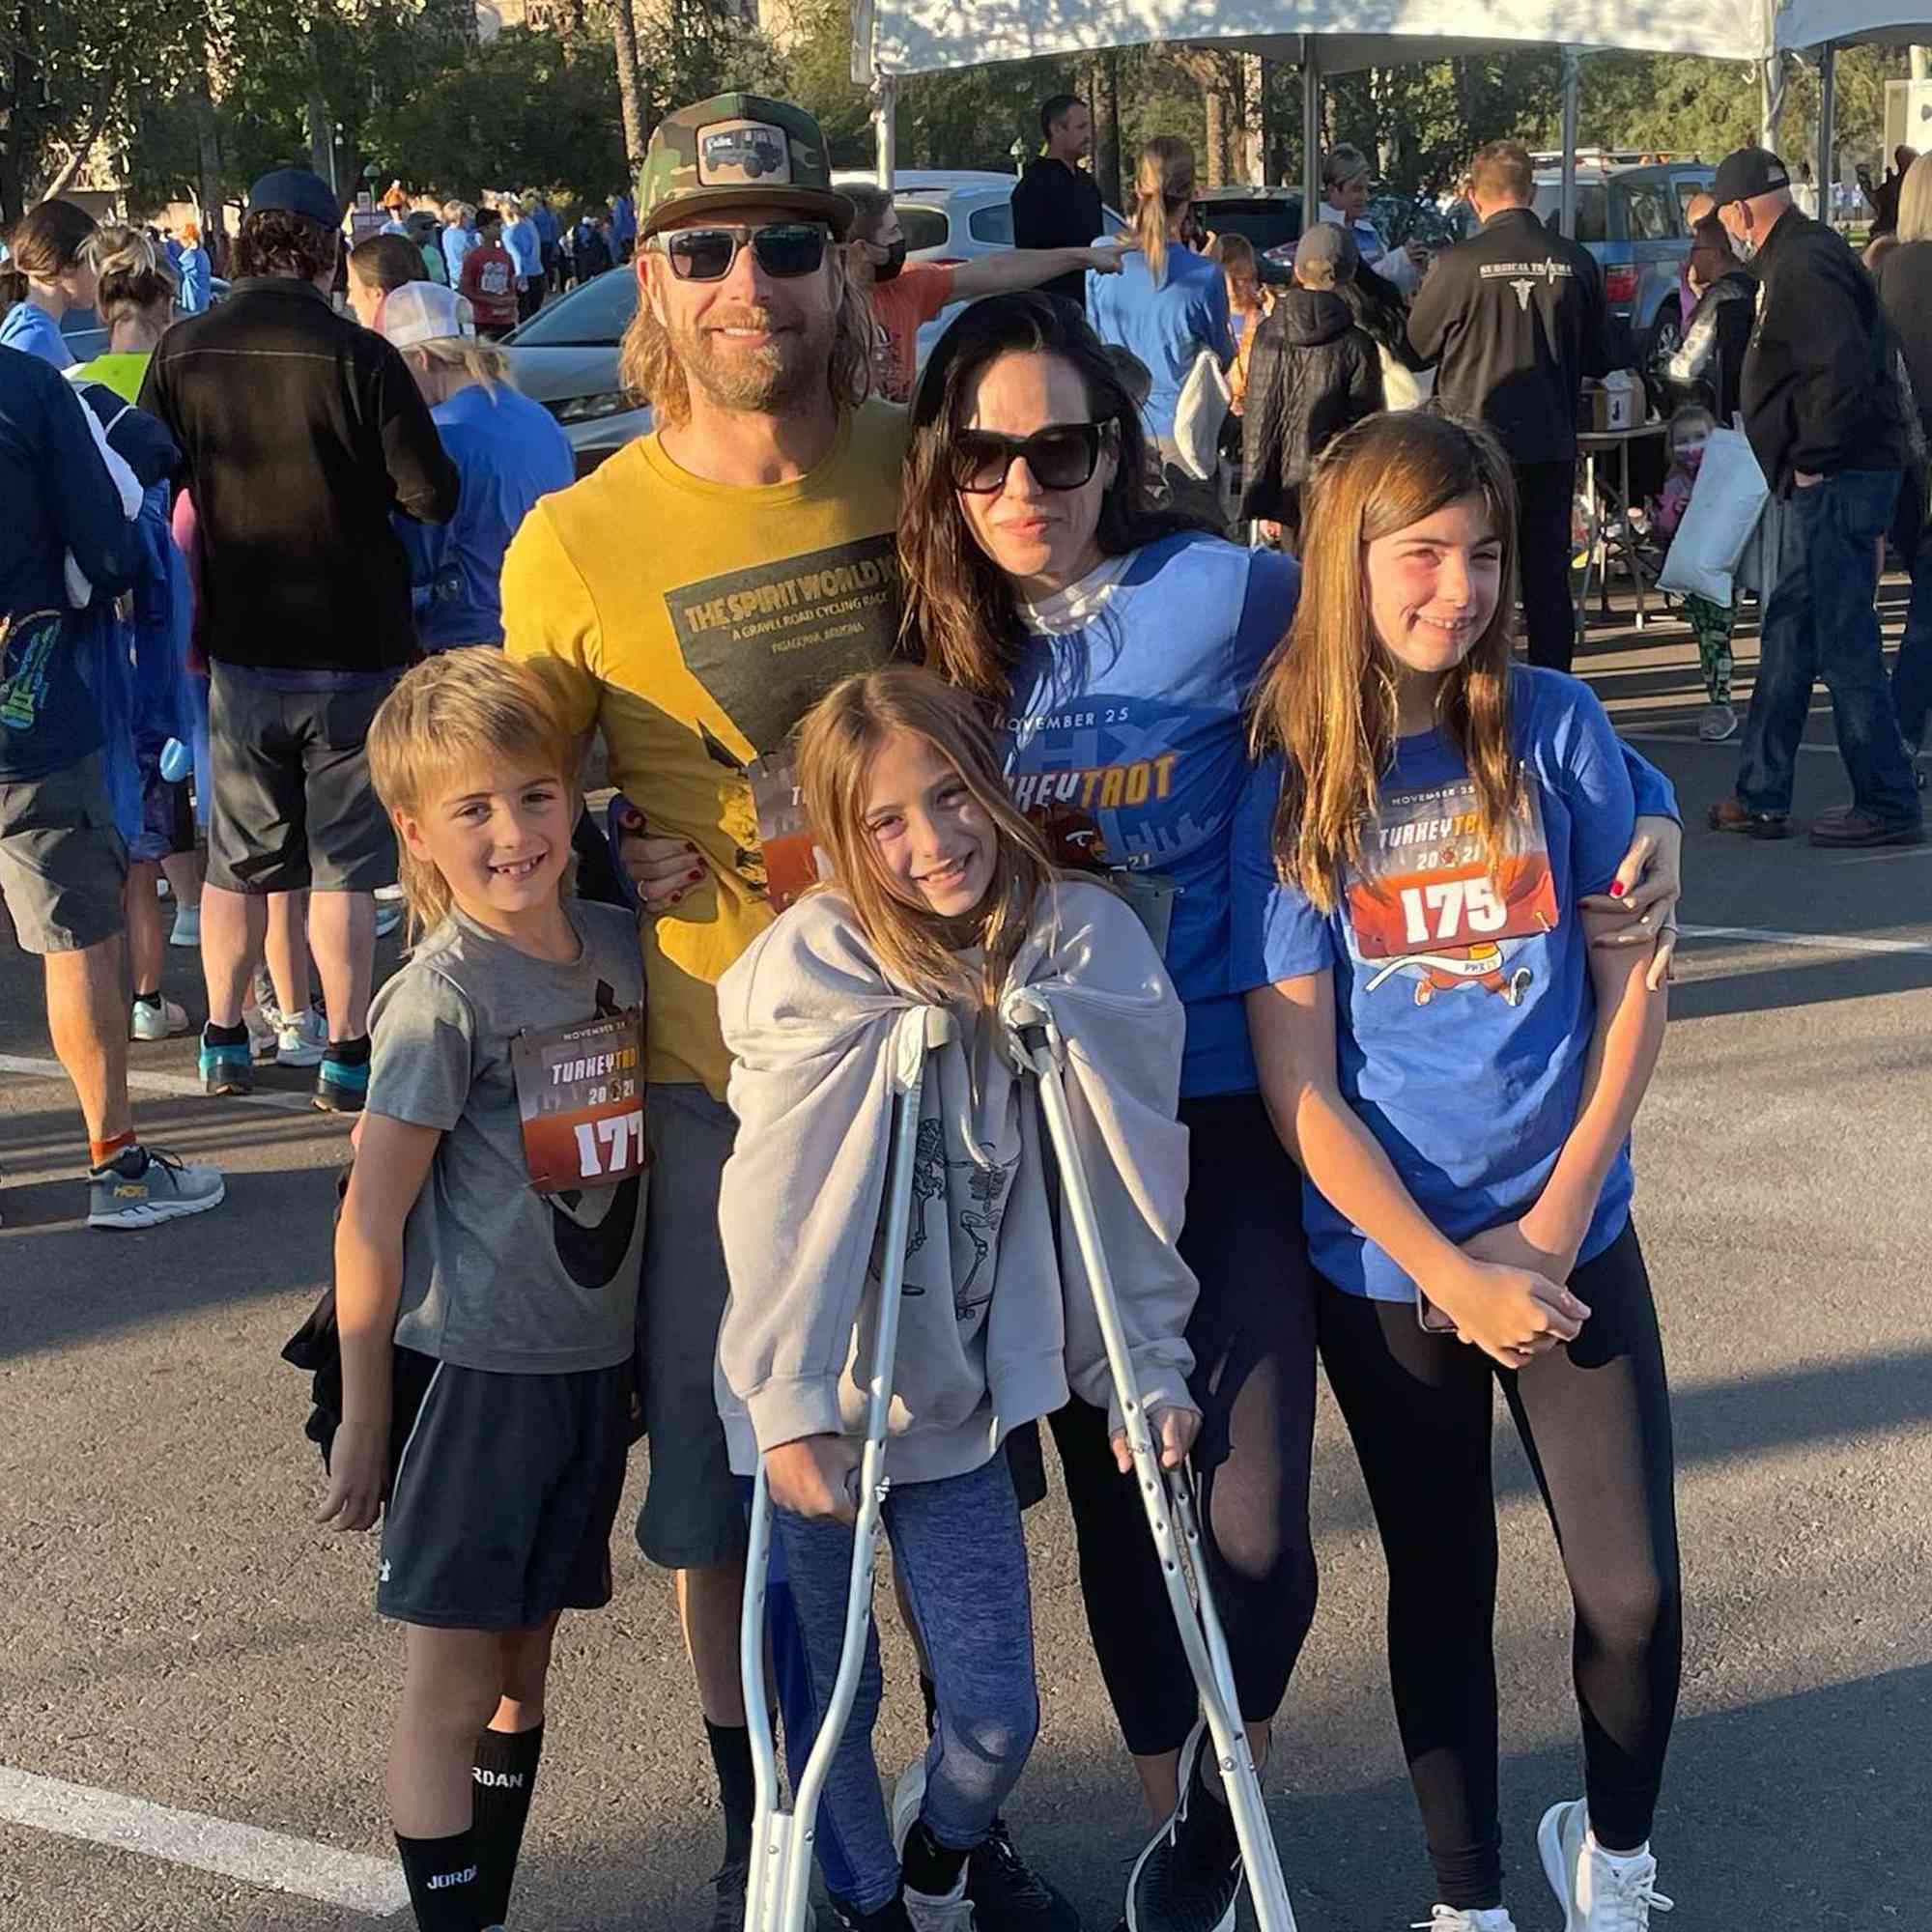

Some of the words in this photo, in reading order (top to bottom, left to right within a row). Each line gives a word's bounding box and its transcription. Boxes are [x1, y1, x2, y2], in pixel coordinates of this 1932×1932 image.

[684, 598, 728, 634] THE
[725, 580, 800, 622] SPIRIT
[796, 559, 879, 603] WORLD
[732, 628, 742, 641] A
[742, 617, 782, 639] GRAVEL
[781, 609, 814, 629] ROAD
[815, 596, 863, 618] CYCLING
[1104, 707, 1129, 724] 25
[1391, 786, 1456, 807] NOVEMBER
[1416, 851, 1439, 870] 20
[1401, 876, 1508, 944] 175
[562, 1024, 613, 1041] NOVEMBER
[587, 1086, 608, 1106] 20
[574, 1110, 644, 1178] 177
